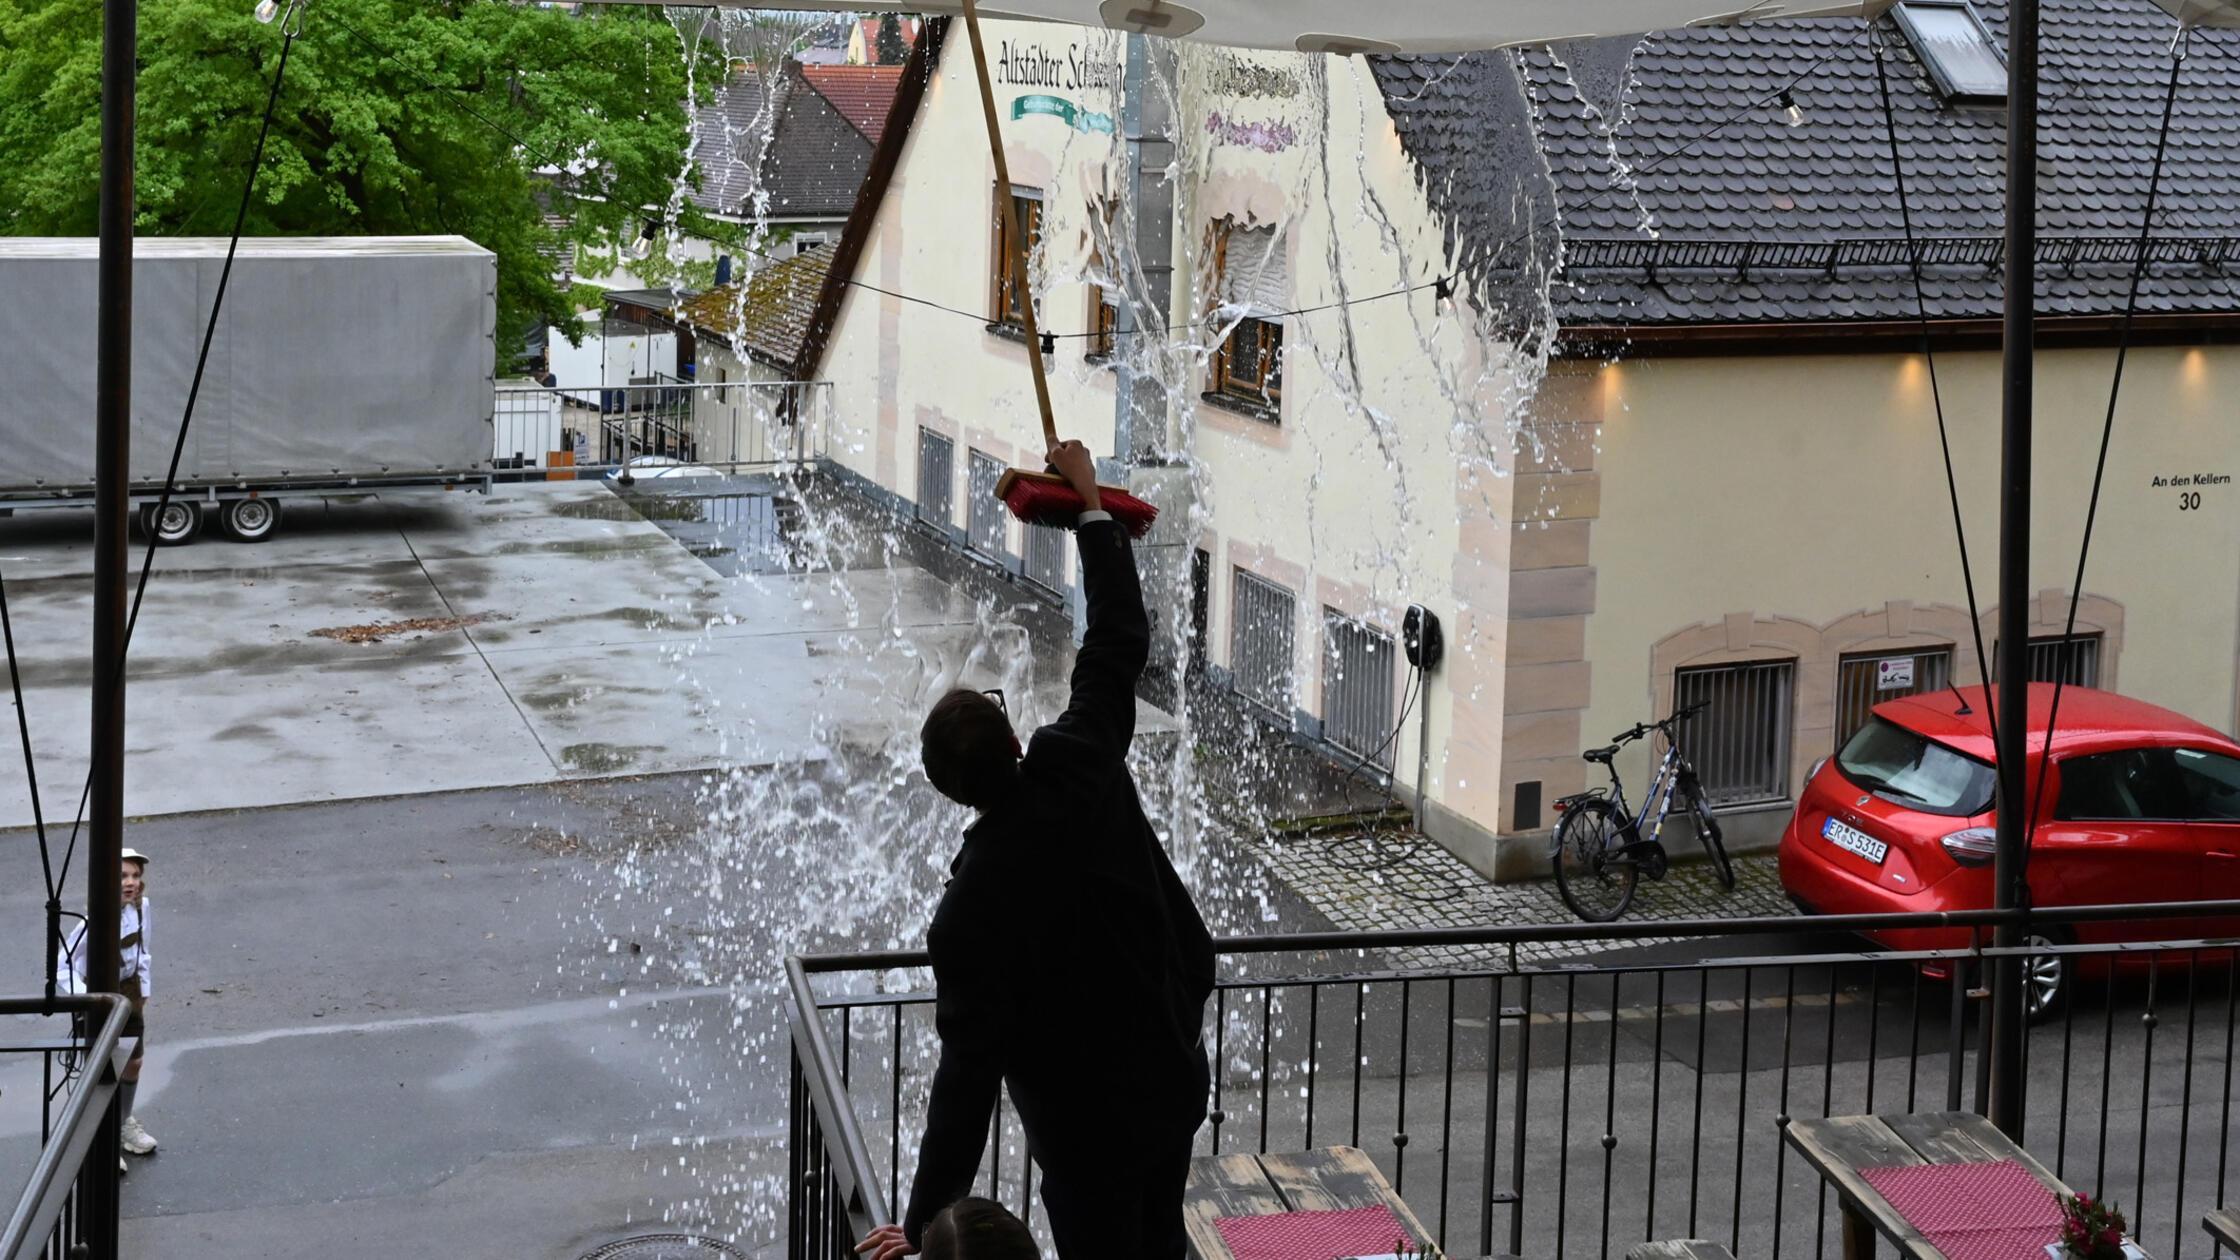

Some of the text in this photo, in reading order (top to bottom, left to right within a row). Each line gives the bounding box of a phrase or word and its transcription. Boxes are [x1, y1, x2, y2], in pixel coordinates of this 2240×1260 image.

[998, 38, 1063, 88] Altstädter
[2152, 473, 2231, 487] An den Kellern
[2179, 492, 2201, 511] 30
[1828, 821, 1844, 839] ER
